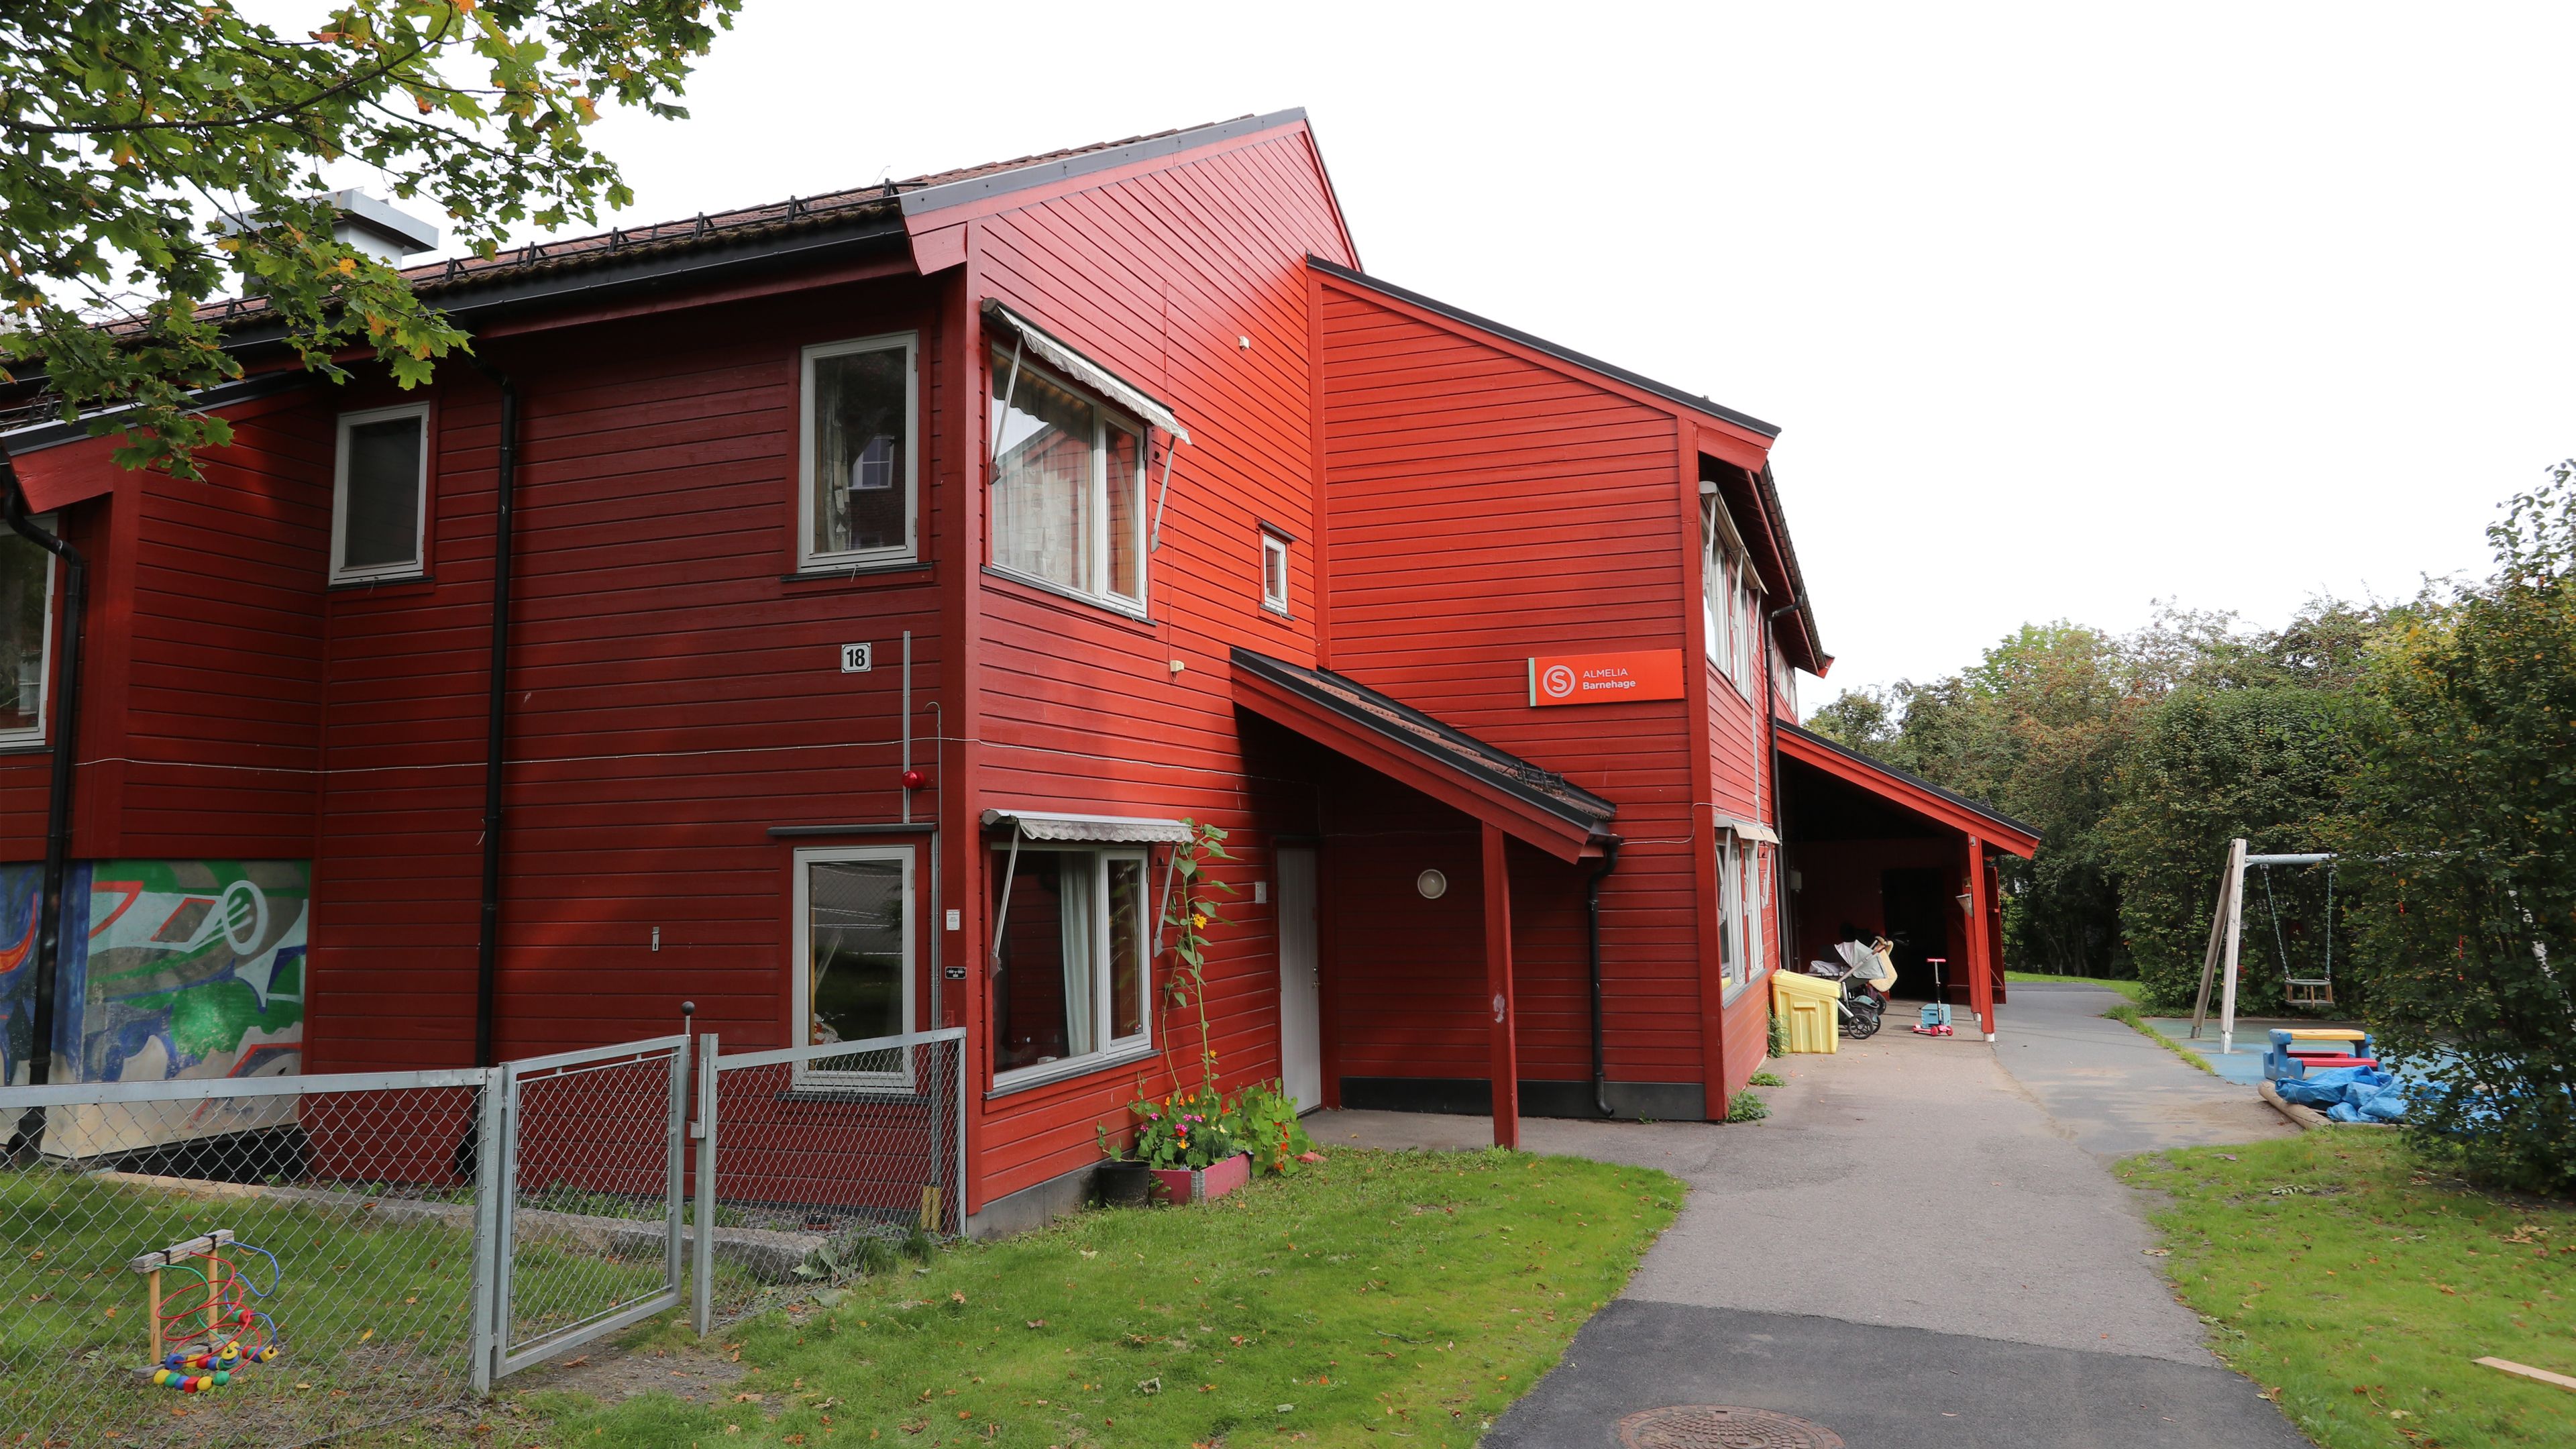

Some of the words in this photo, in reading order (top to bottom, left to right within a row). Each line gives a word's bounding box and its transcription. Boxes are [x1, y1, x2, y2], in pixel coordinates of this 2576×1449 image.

[847, 648, 865, 667] 18
[1582, 668, 1628, 678] ALMELIA
[1582, 680, 1636, 690] Barnehage
[1678, 1434, 1750, 1445] BASAL
